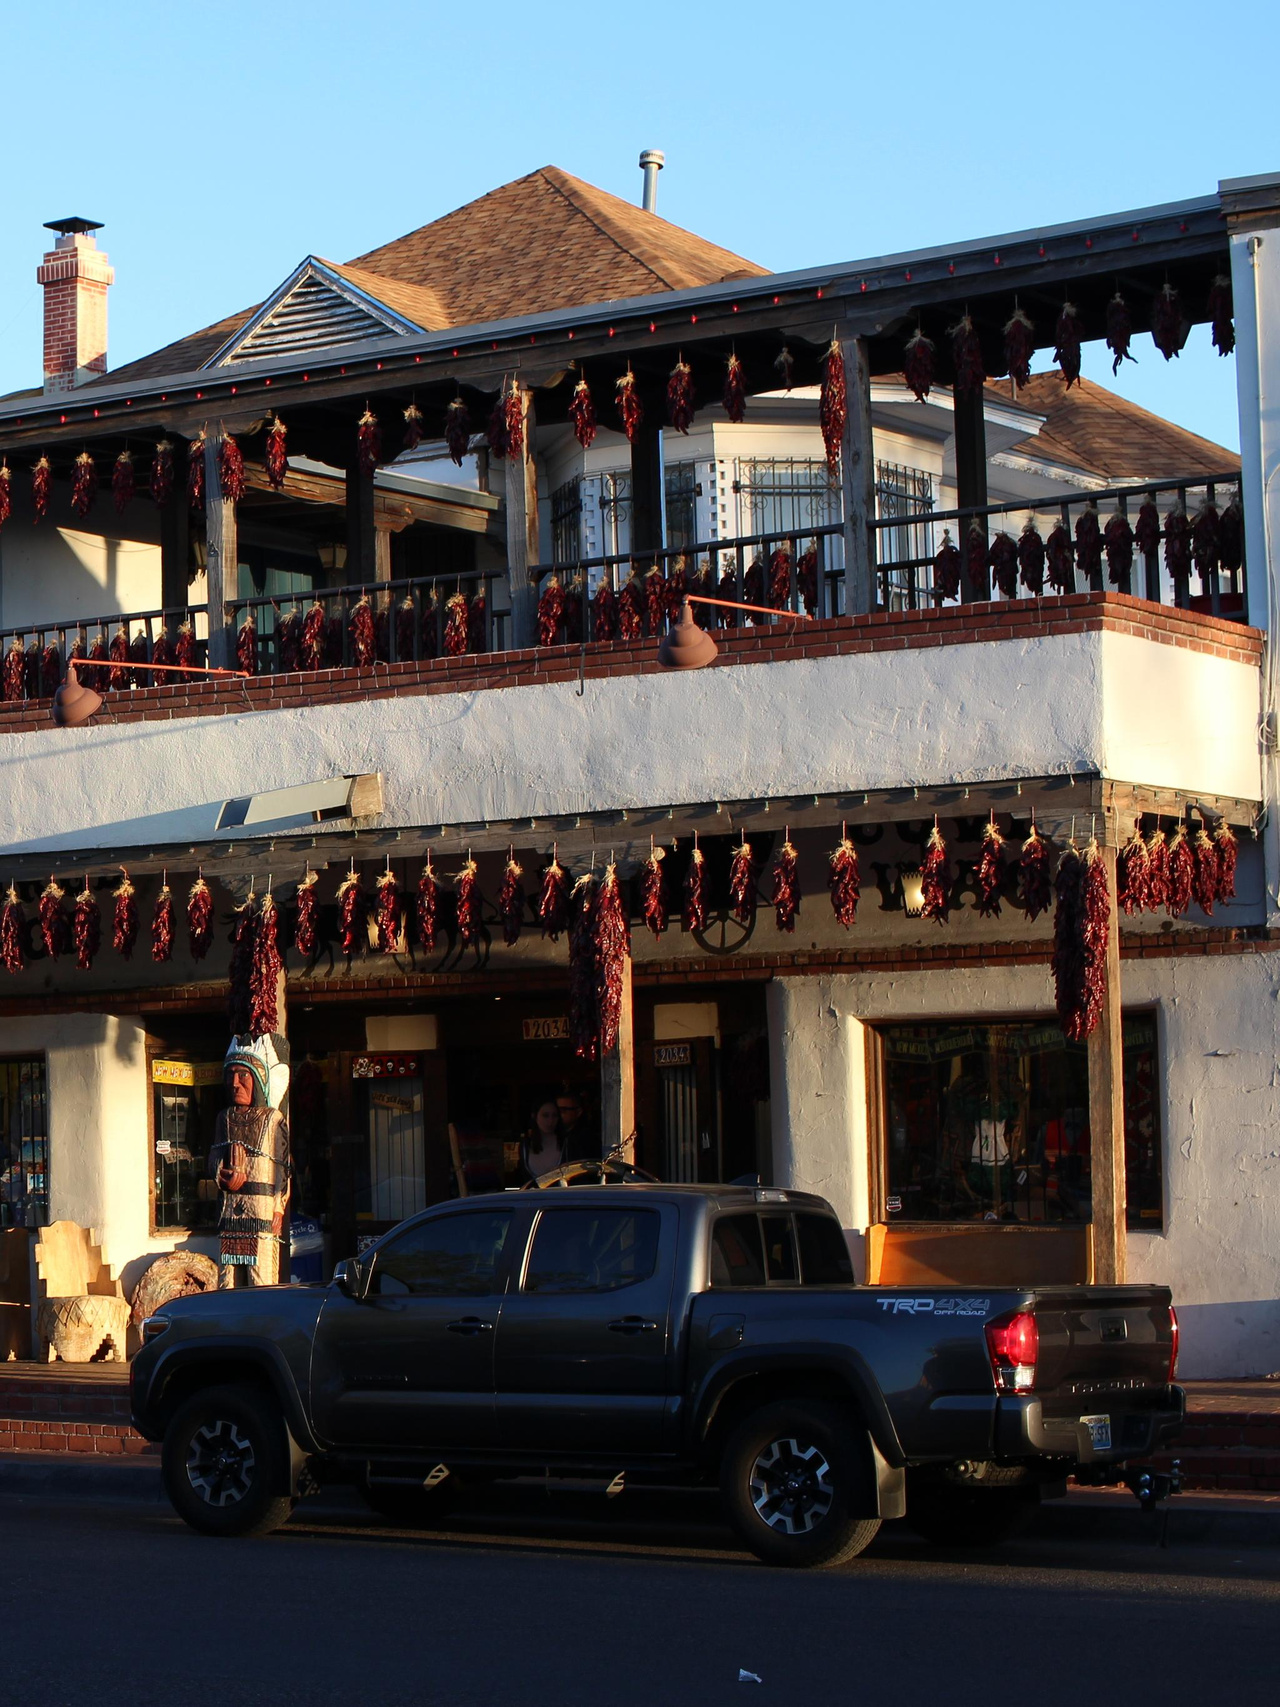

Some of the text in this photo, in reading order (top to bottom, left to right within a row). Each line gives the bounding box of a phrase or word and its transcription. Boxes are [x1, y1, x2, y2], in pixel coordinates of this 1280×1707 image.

[533, 1019, 569, 1037] 2034
[660, 1047, 684, 1063] 2034
[876, 1298, 991, 1314] TRD 4X4
